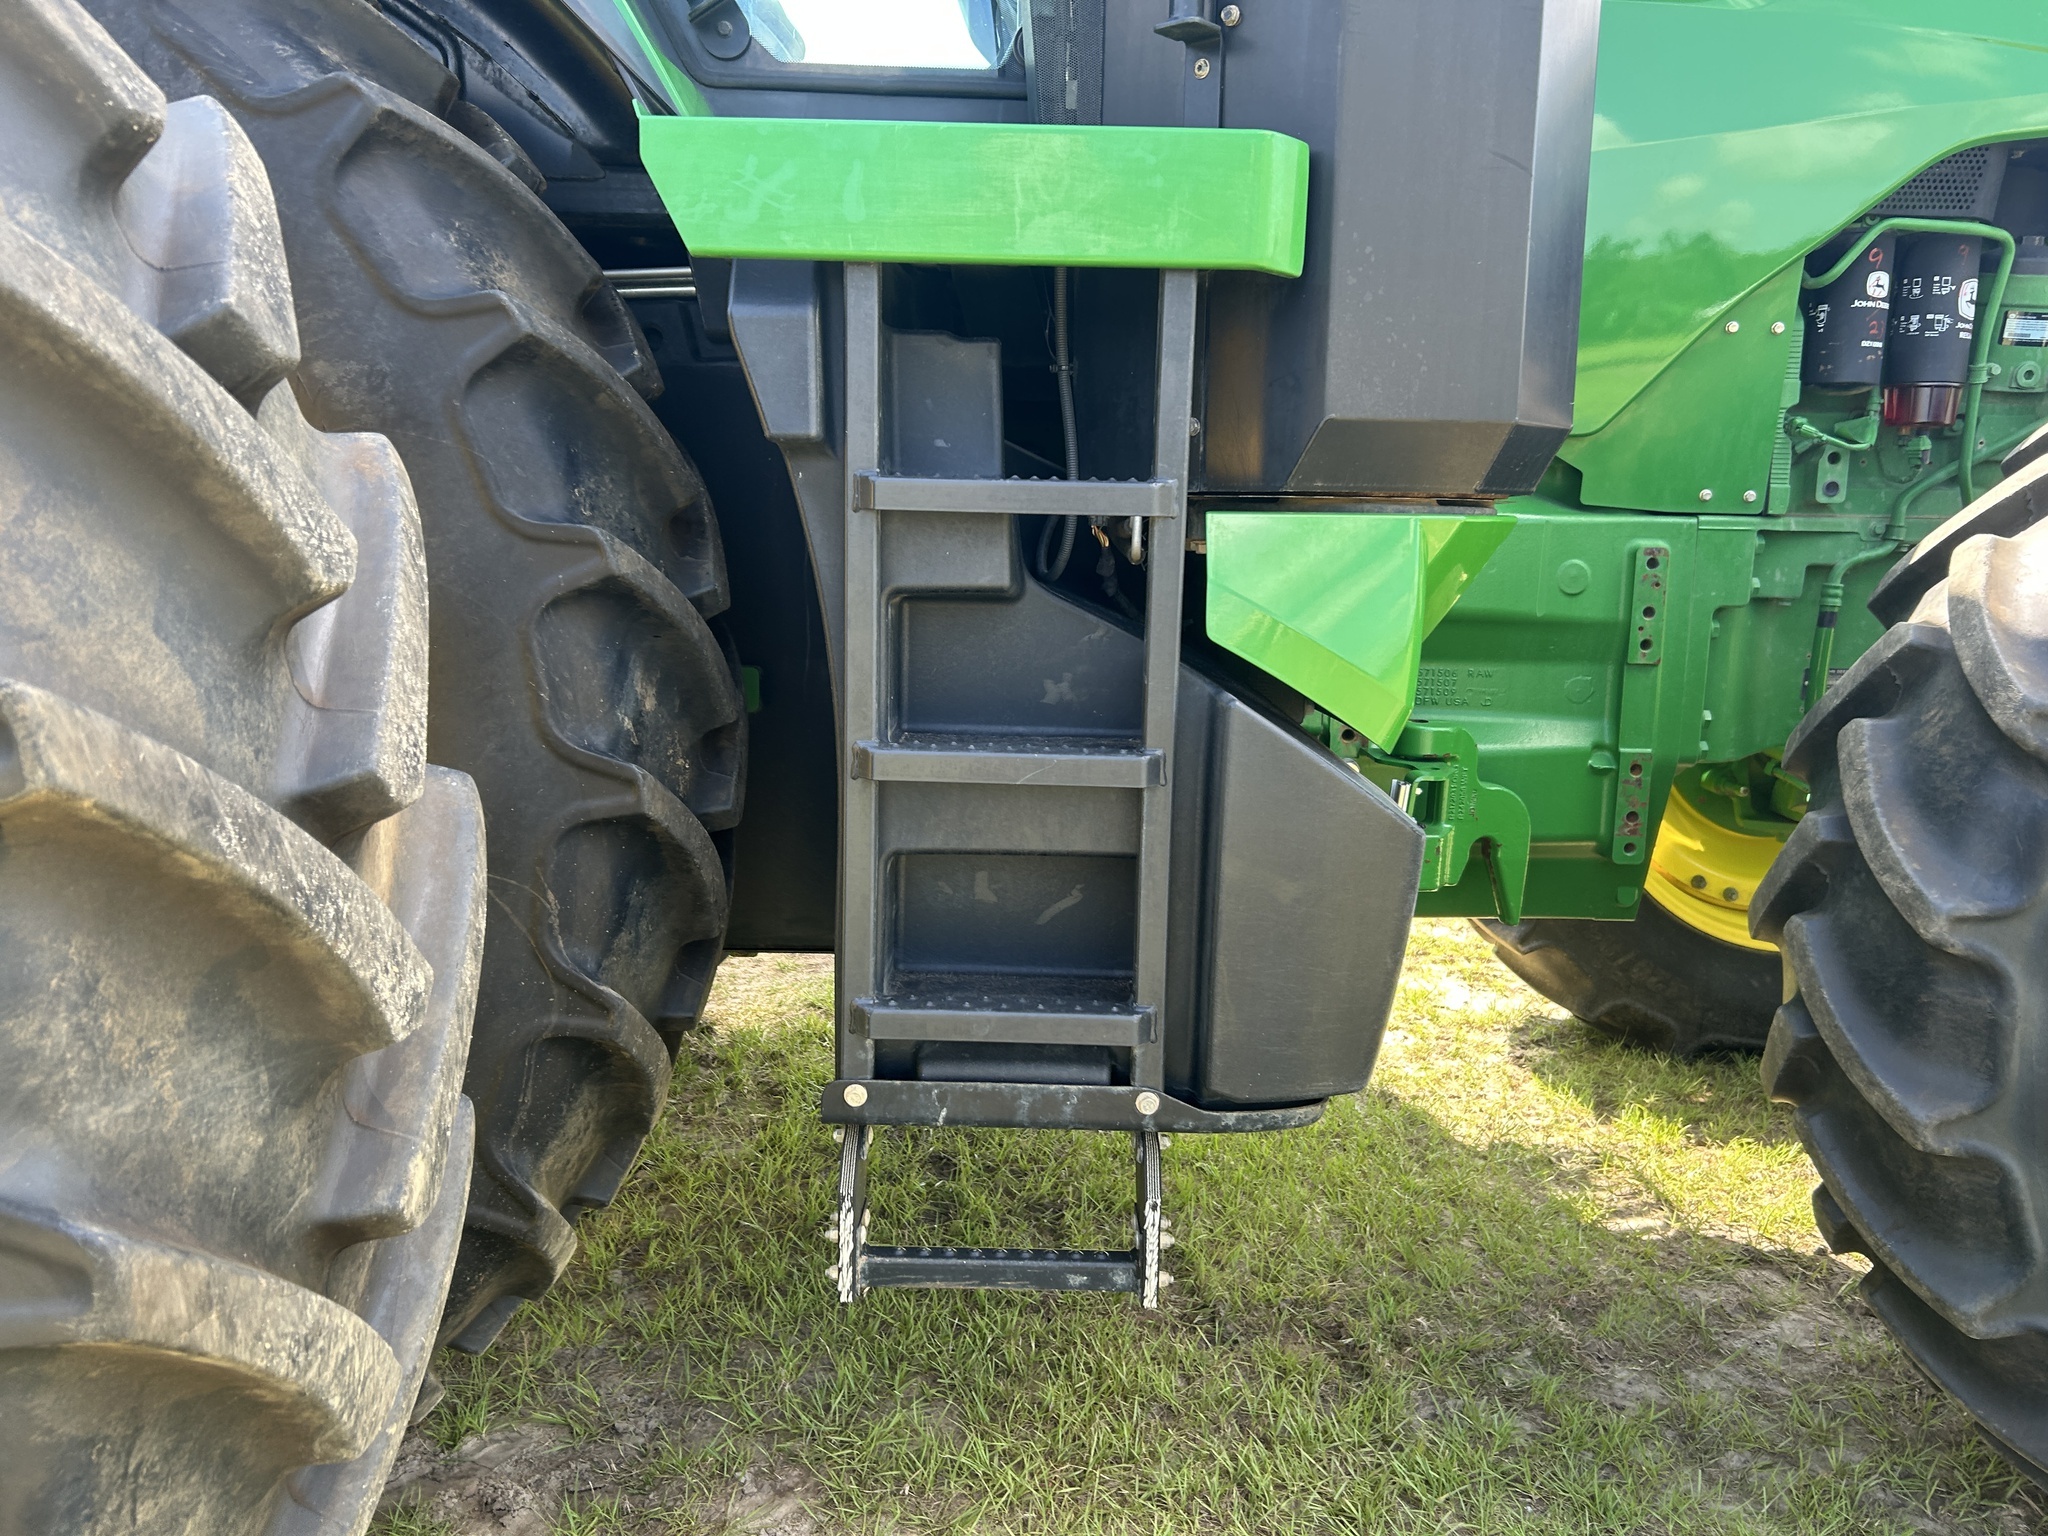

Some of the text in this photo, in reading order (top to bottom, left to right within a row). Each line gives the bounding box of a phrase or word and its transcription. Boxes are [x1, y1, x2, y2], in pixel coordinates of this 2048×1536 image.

[1850, 299, 1876, 308] JOHN
[1467, 668, 1493, 679] RAW
[1417, 677, 1458, 687] 571507
[1415, 687, 1457, 697] 571509
[1445, 696, 1469, 706] USA
